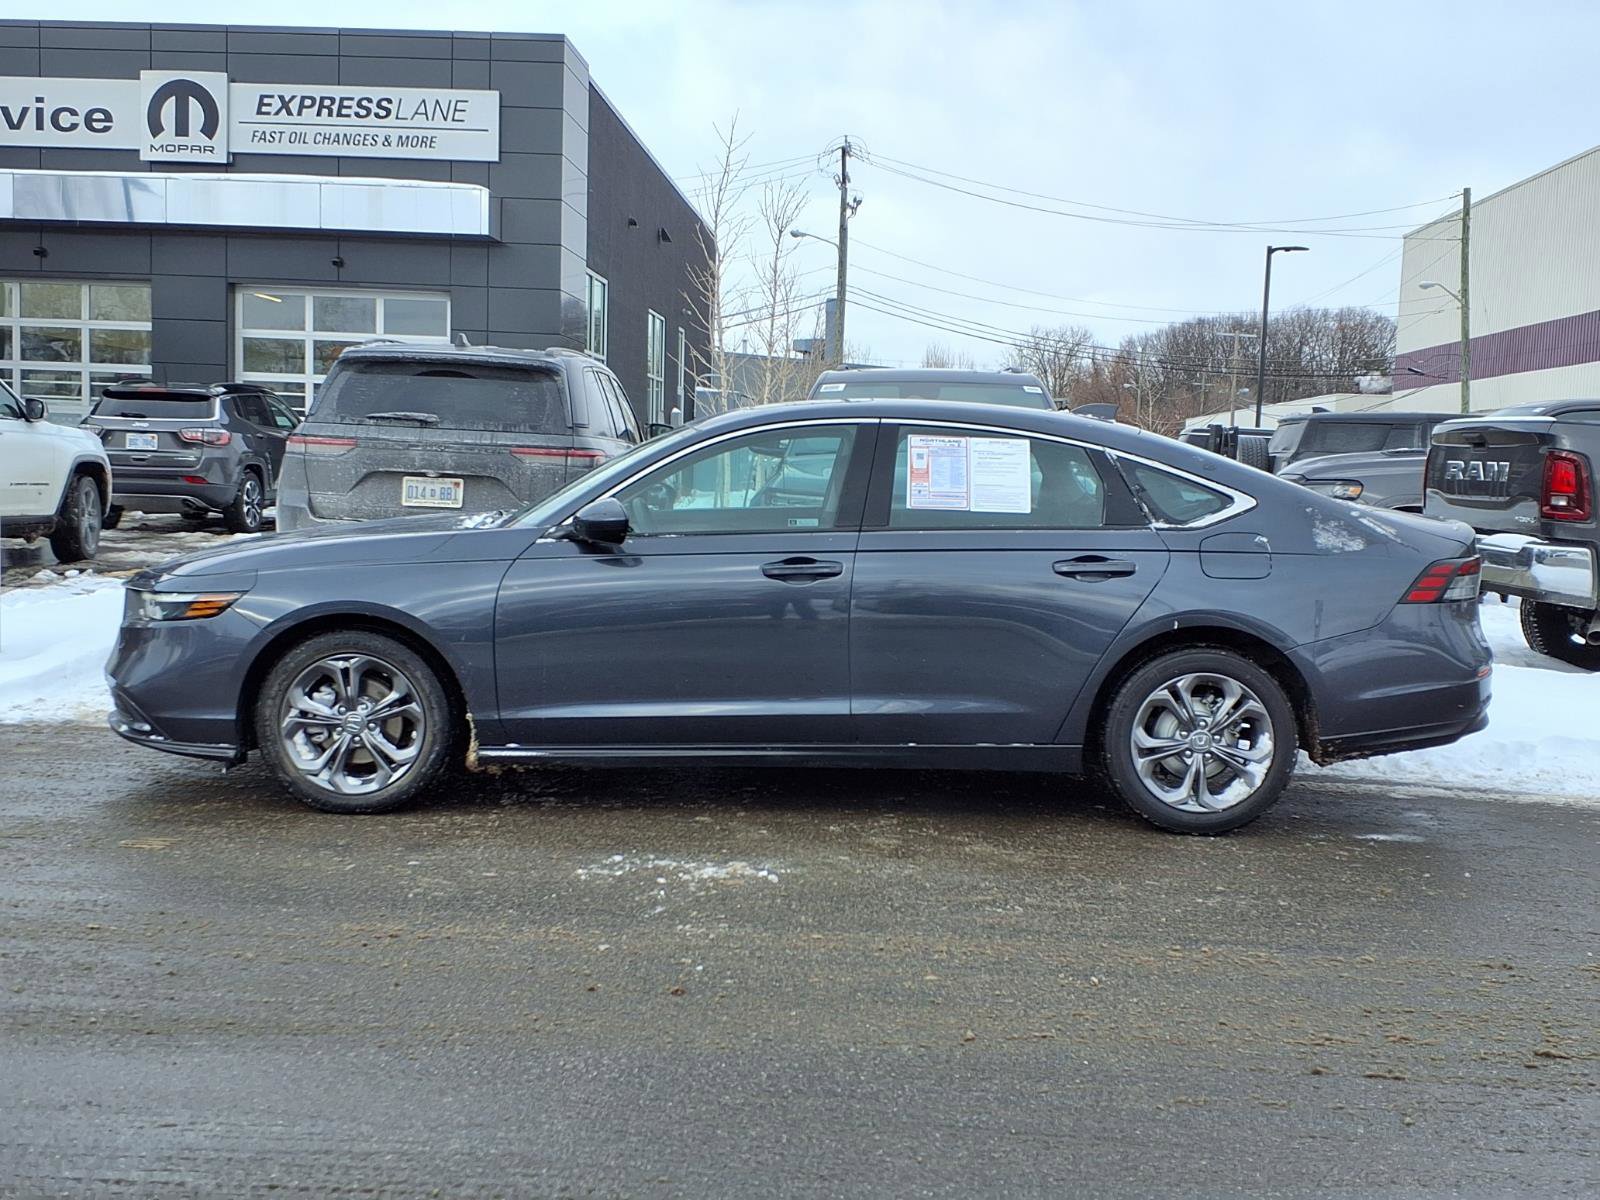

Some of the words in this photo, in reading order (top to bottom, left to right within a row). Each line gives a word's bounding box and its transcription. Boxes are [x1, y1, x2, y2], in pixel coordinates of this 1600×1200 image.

[0, 96, 114, 133] vice
[150, 144, 215, 154] MOPAR
[251, 130, 286, 144] FAST
[288, 131, 309, 145] OIL
[313, 132, 379, 147] CHANGES
[382, 134, 392, 147] &
[396, 135, 438, 149] MORE
[1444, 460, 1510, 482] RAM
